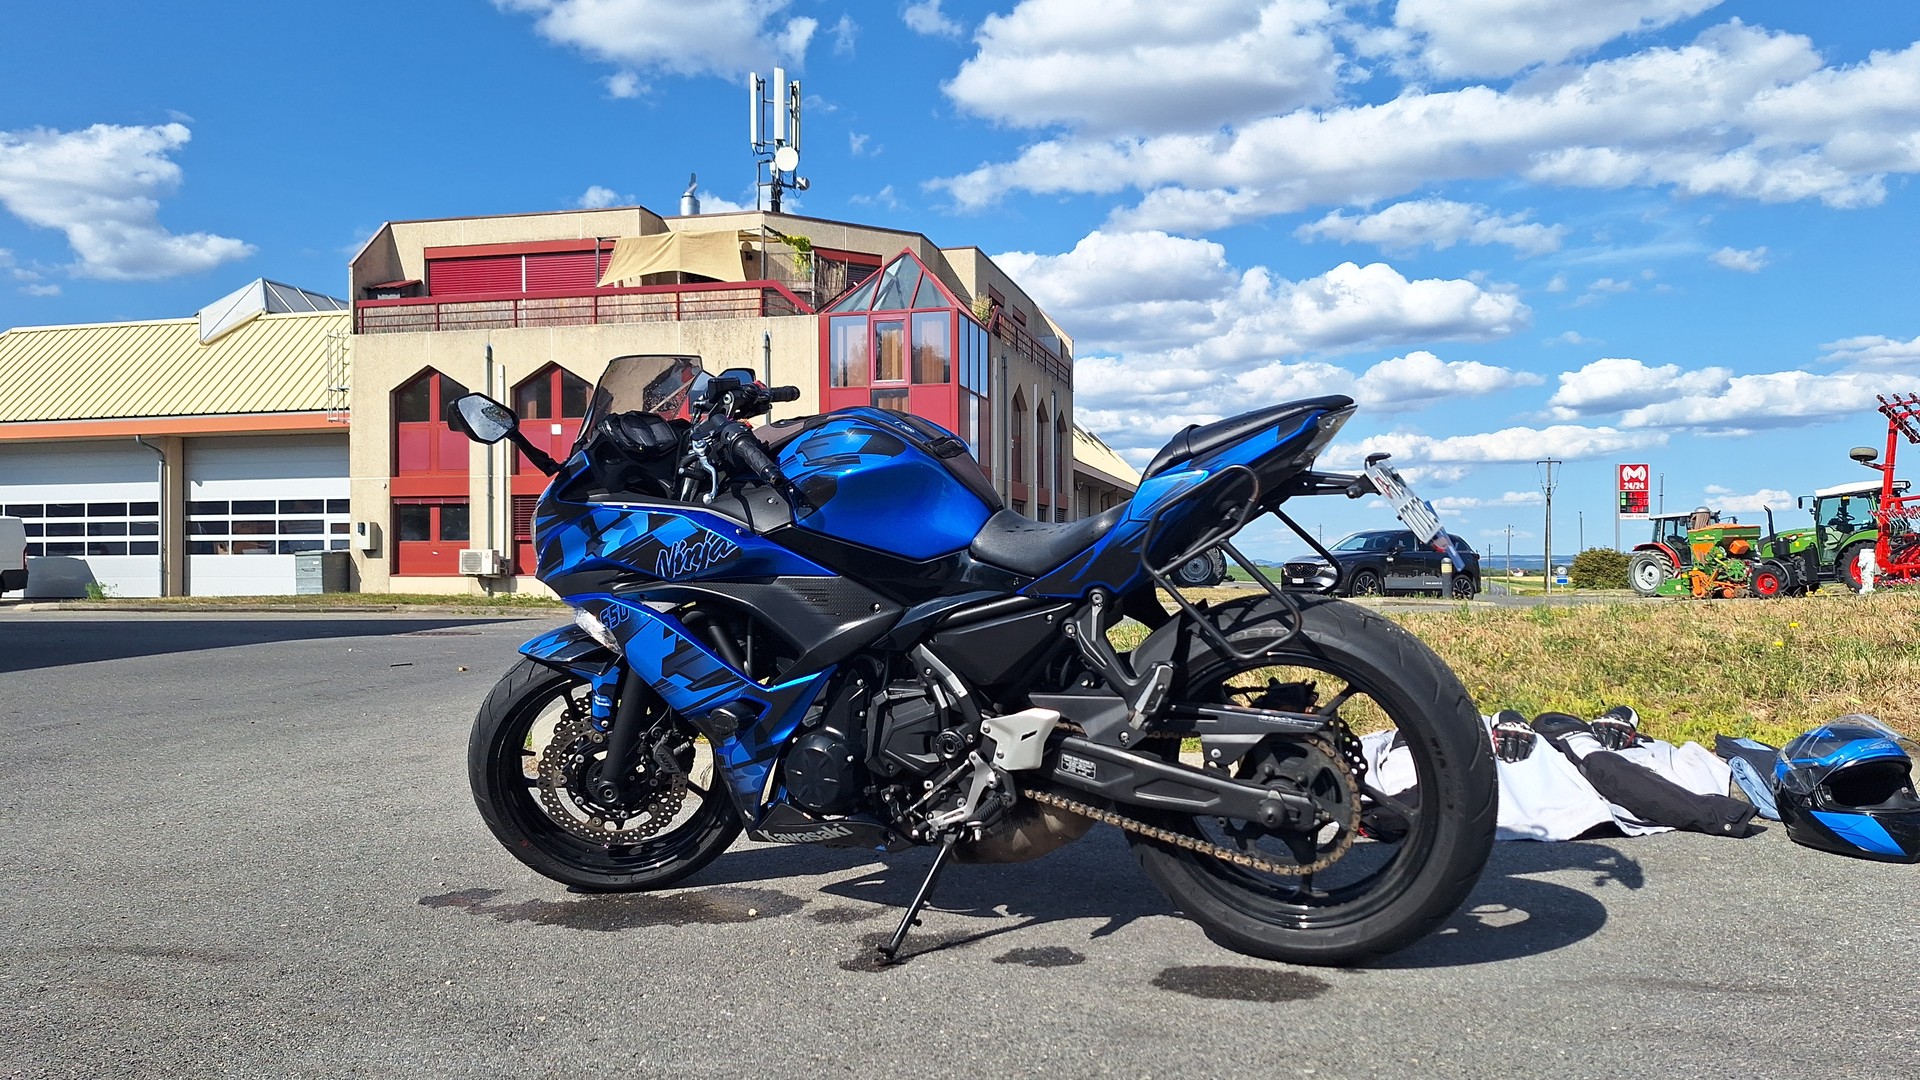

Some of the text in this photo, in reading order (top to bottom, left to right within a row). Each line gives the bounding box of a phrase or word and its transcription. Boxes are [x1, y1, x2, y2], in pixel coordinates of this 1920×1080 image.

[1624, 482, 1645, 490] 24/24
[655, 530, 738, 578] Ninja
[600, 602, 629, 630] 650
[757, 823, 854, 843] Kawasaki
